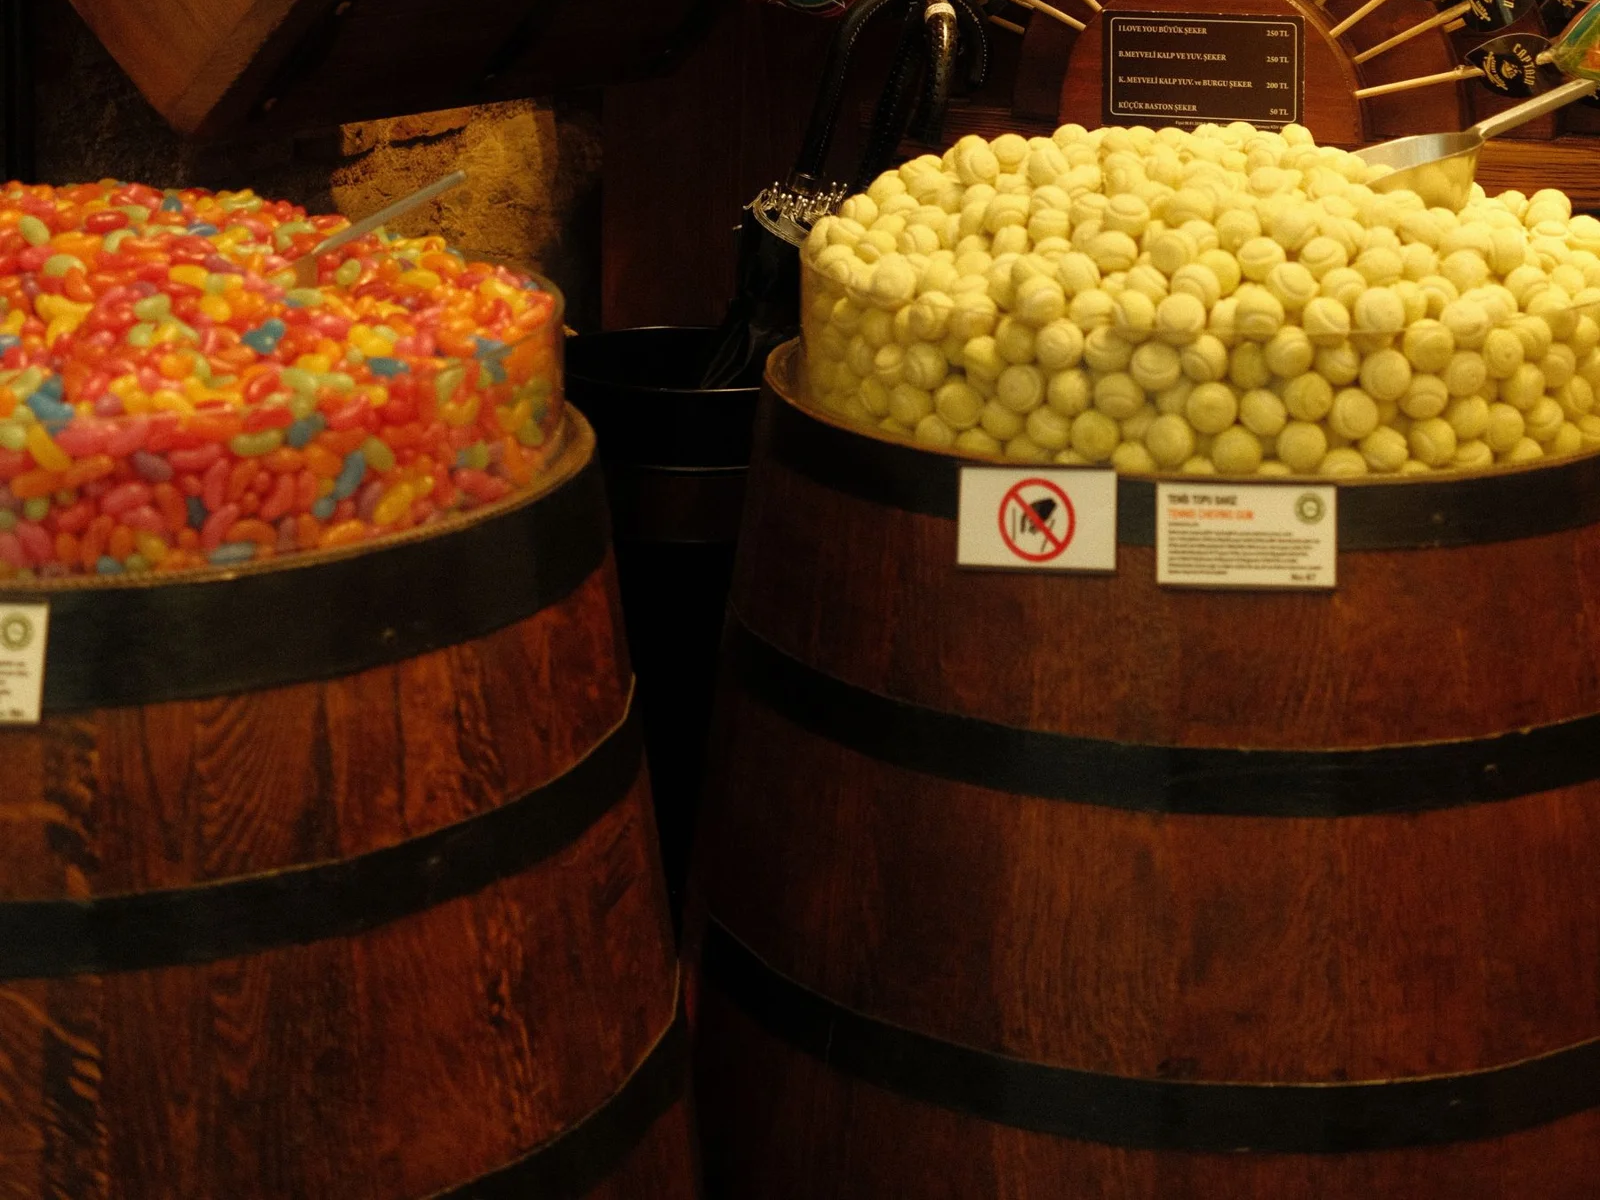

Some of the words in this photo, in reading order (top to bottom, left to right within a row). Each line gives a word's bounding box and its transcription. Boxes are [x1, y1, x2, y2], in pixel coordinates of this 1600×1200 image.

[1122, 24, 1141, 32] LOVE
[1142, 25, 1158, 33] YOU
[1158, 25, 1184, 34] BÜYÜK
[1184, 26, 1207, 35] ŞEKER
[1266, 29, 1279, 37] 250
[1156, 51, 1176, 59] KALP
[1186, 52, 1203, 60] YUV.
[1203, 53, 1227, 62] ŞEKER
[1512, 43, 1536, 86] CAPTAIN
[1118, 75, 1126, 83] K.
[1126, 76, 1158, 84] MEYVELİ
[1158, 77, 1178, 85] KALP
[1178, 78, 1194, 86] YUV.
[1202, 79, 1228, 87] BURGU
[1228, 80, 1253, 89] ŞEKER
[1265, 81, 1279, 89] 200
[1279, 82, 1290, 90] TL
[1118, 100, 1144, 111] KÜÇÜK
[1144, 102, 1174, 110] BASTON
[1174, 103, 1198, 113] ŞEKER
[1269, 108, 1278, 116] 50
[1279, 108, 1290, 116] TL
